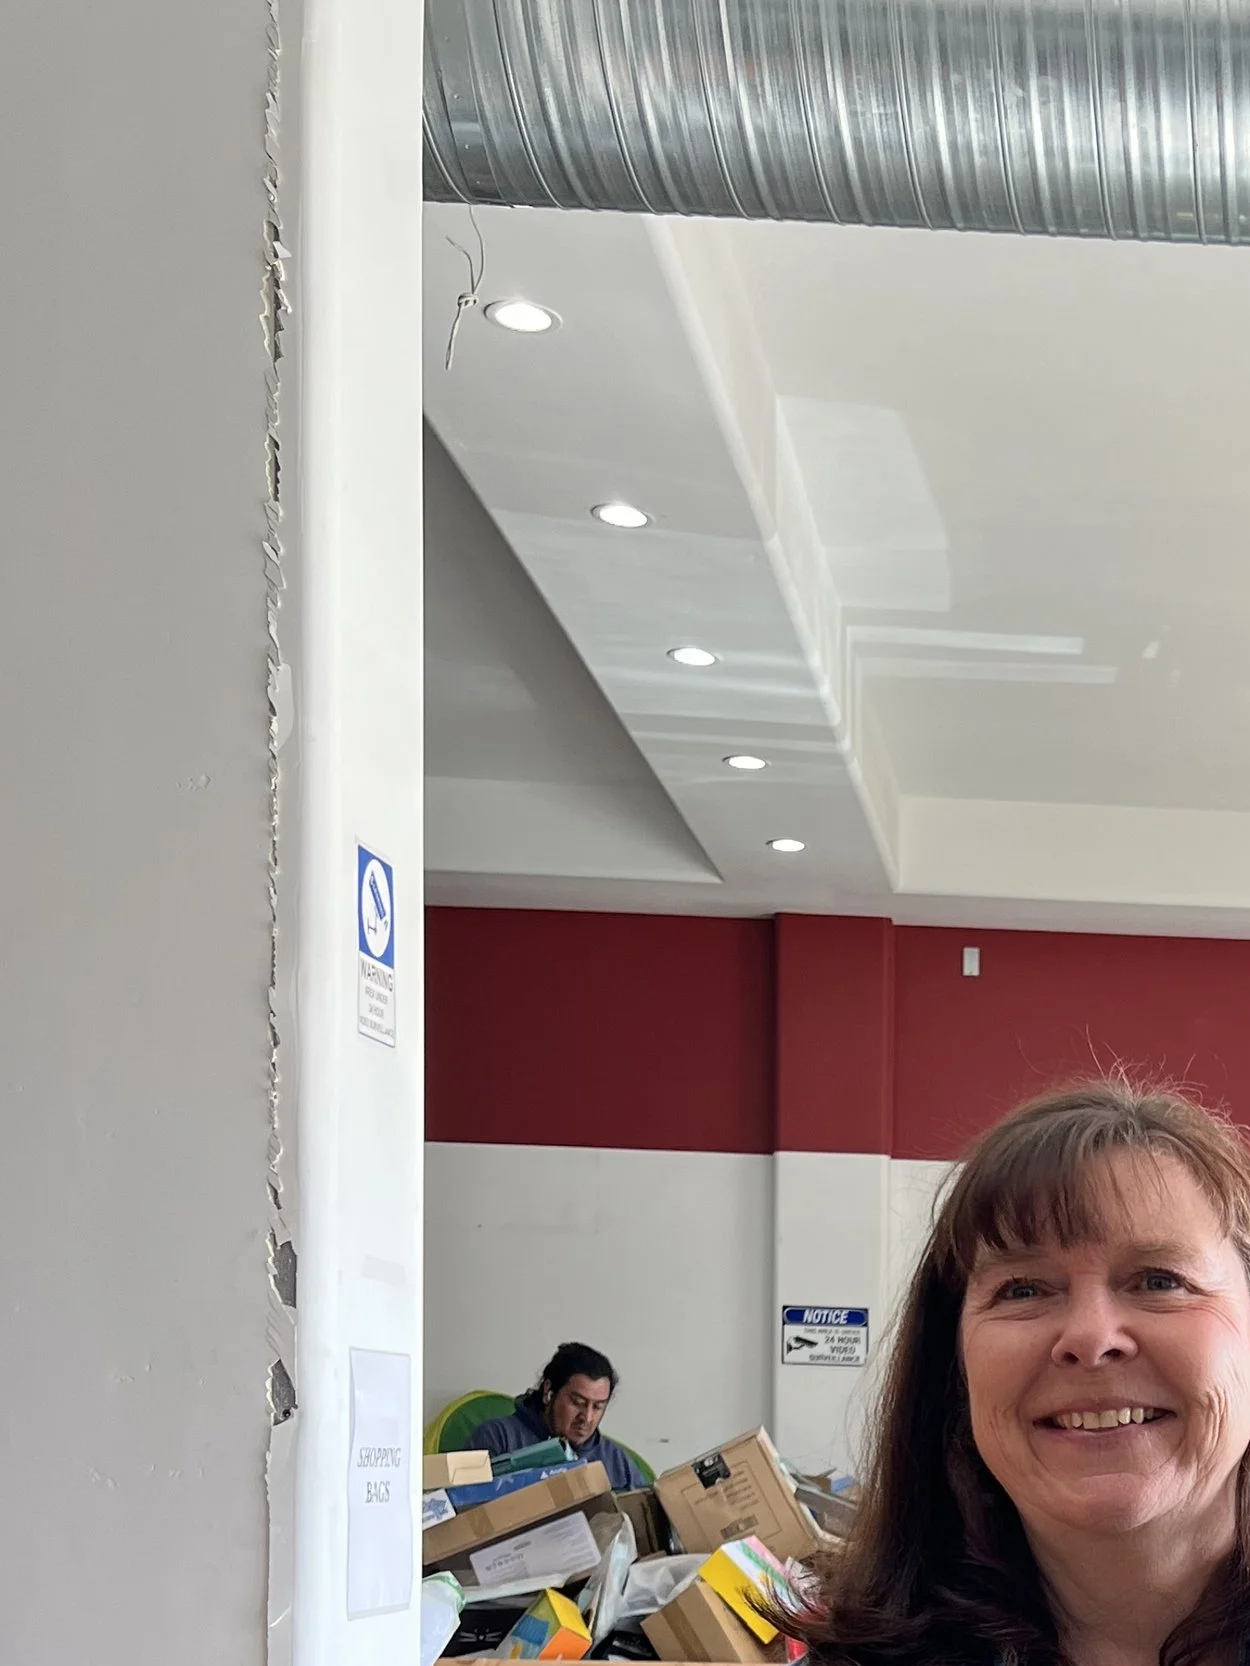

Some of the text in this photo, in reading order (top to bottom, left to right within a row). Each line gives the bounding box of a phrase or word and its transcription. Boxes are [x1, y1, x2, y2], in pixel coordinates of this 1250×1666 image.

[361, 957, 393, 992] WARNING
[803, 1308, 849, 1324] NOTICE
[357, 1446, 401, 1467] SHOPPING
[365, 1480, 390, 1503] BAGS
